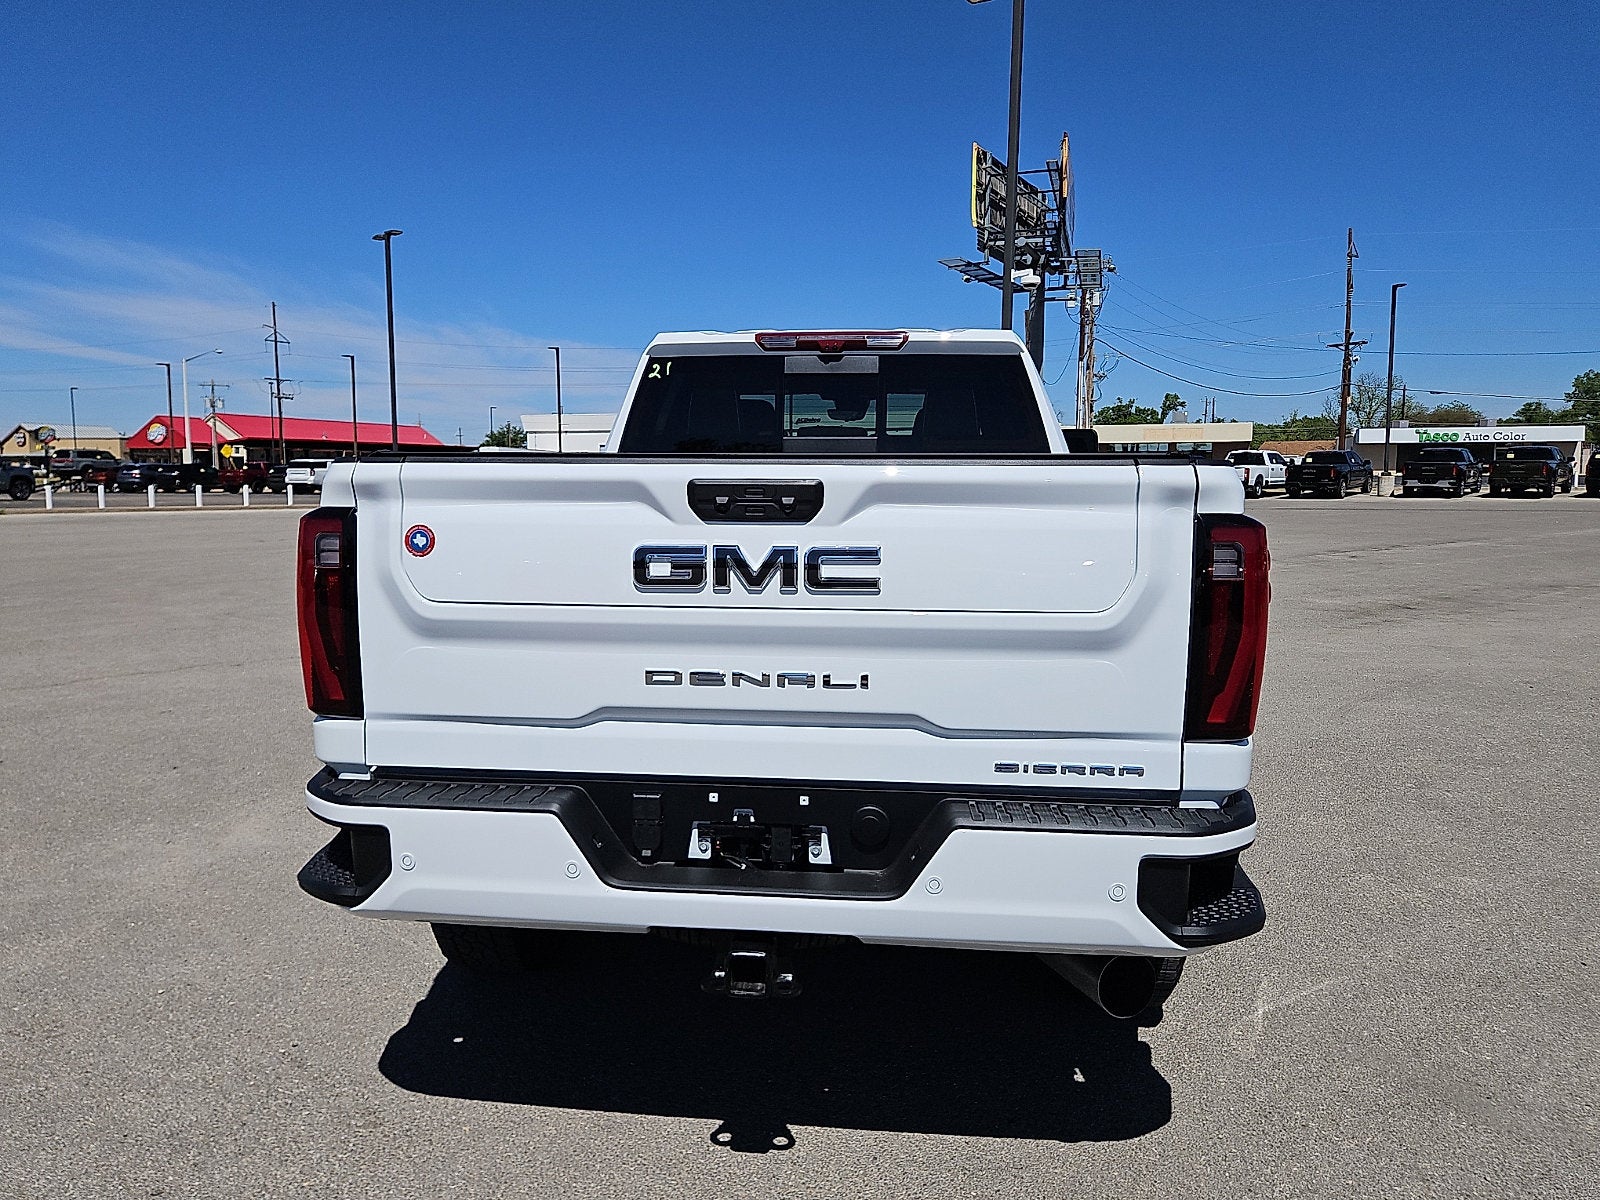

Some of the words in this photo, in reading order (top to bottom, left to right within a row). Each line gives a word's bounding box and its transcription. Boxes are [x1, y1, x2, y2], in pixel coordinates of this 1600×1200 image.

[1416, 430, 1459, 442] TASCO
[1463, 433, 1490, 441] Auto
[1493, 432, 1526, 441] Color
[633, 544, 881, 595] GMC
[645, 669, 869, 690] DENALI
[994, 762, 1144, 777] SIERRA
